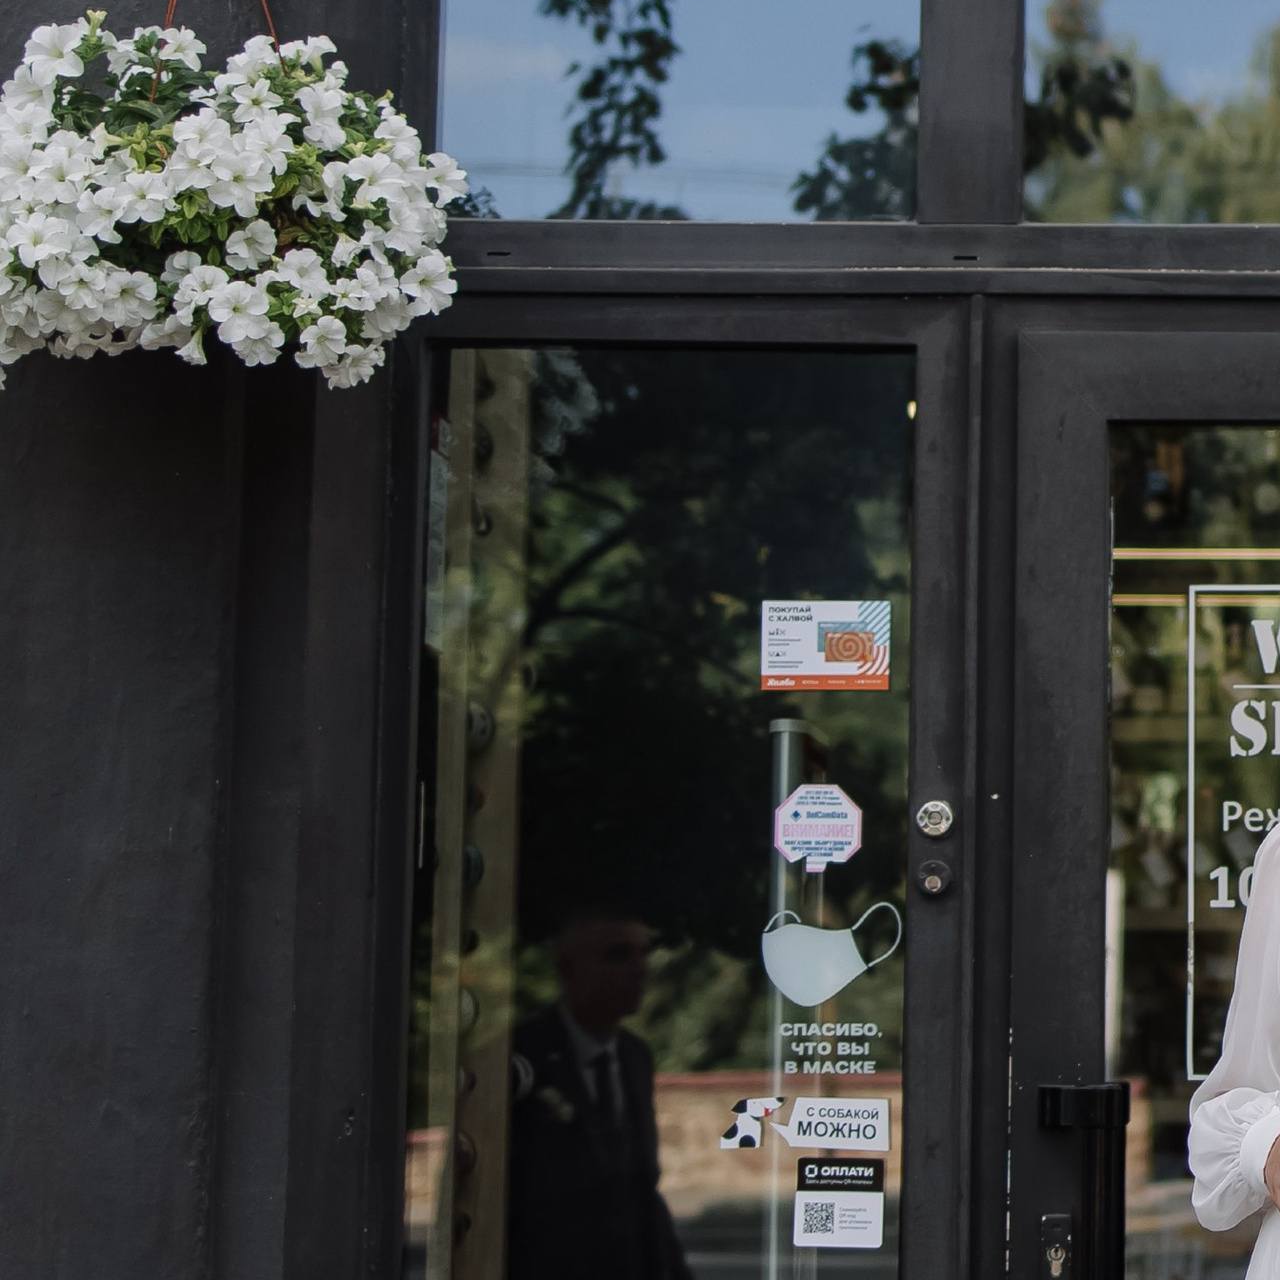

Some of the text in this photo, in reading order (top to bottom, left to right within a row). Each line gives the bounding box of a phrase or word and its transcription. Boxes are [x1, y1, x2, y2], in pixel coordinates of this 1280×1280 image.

[768, 605, 811, 613] ПОКУПАЙ
[776, 614, 813, 622] ХАЛВОЙ
[782, 824, 855, 838] ВНИМАНИЕ!
[780, 1023, 883, 1038] СПАСИБО,
[791, 1042, 870, 1056] ЧТО ВЫ
[784, 1061, 876, 1074] В МАСКЕ
[806, 1107, 879, 1120] С СОБАКОЙ
[797, 1121, 877, 1140] МОЖНО
[821, 1166, 874, 1177] ОПЛАТИ
